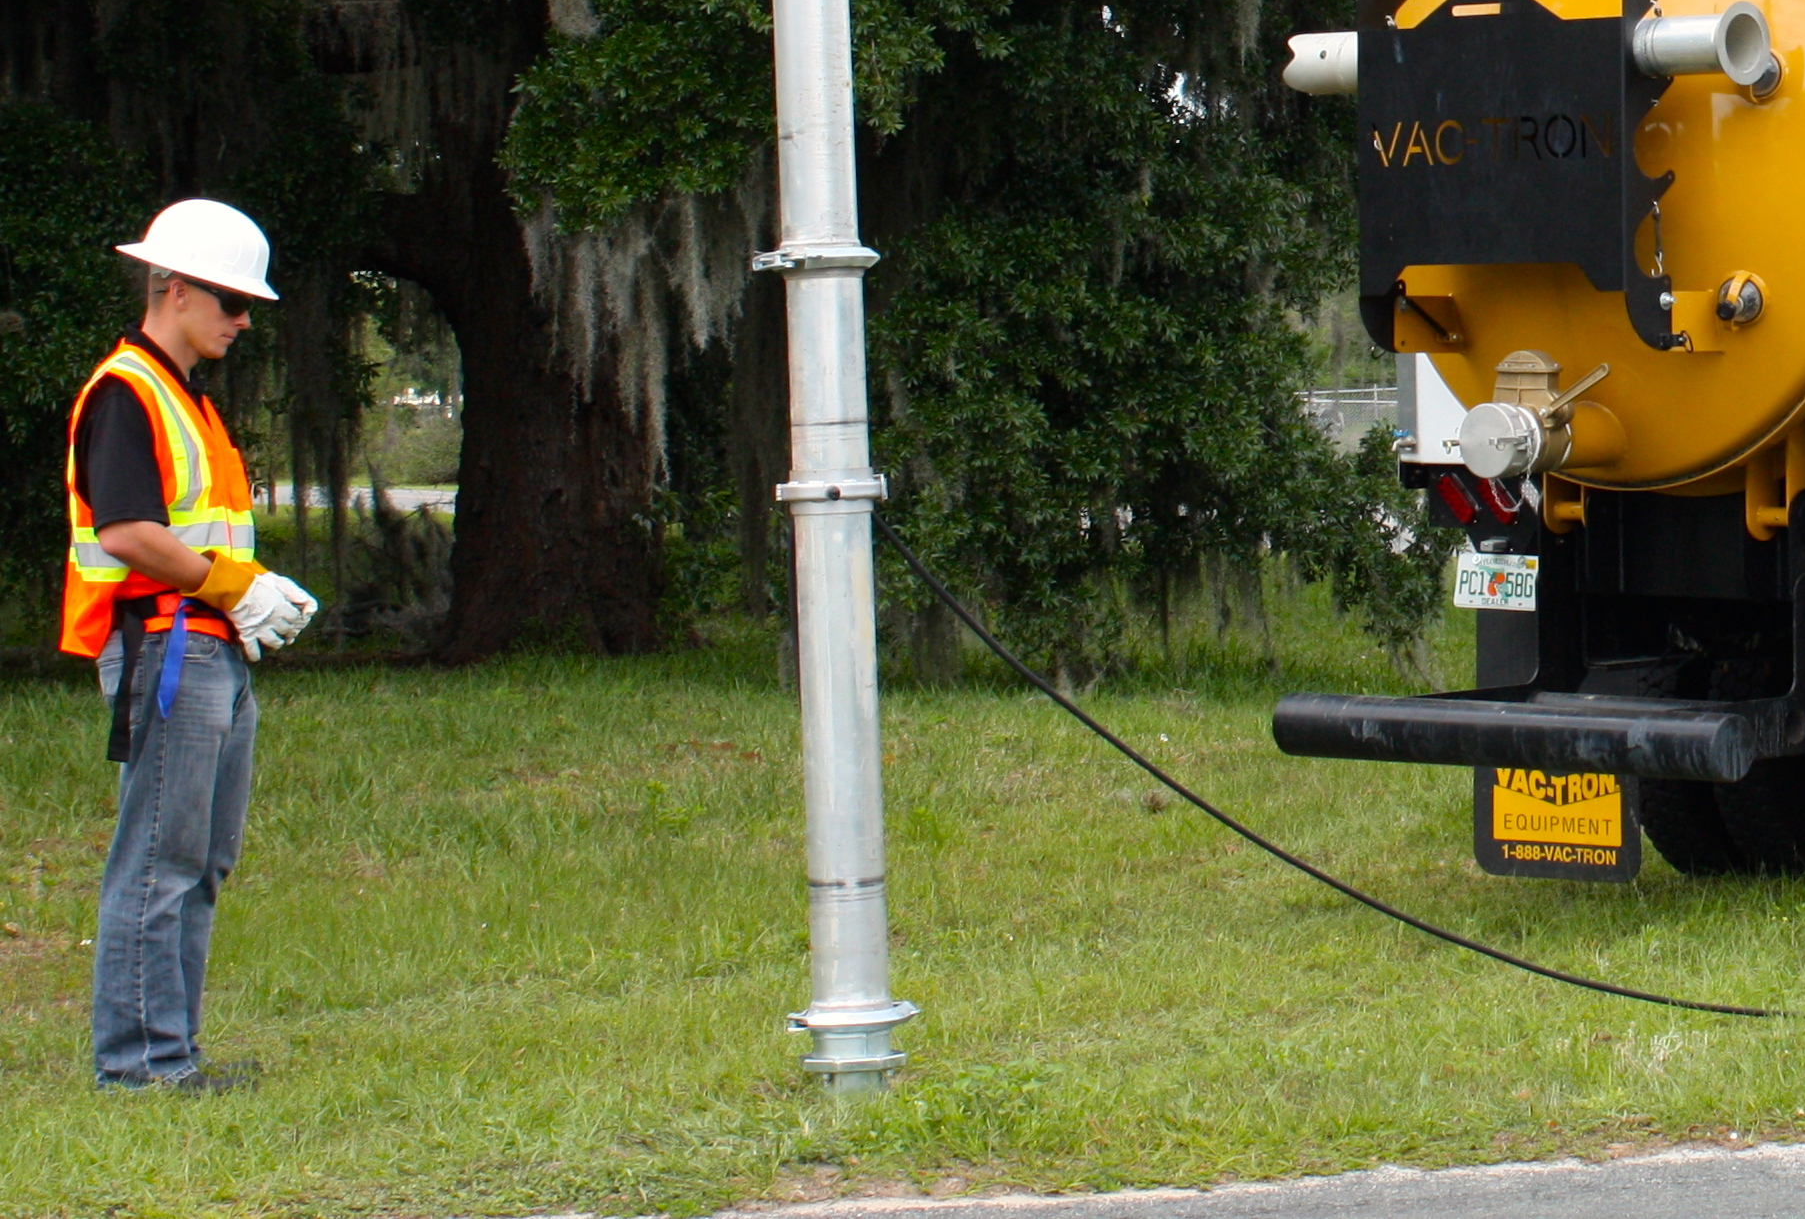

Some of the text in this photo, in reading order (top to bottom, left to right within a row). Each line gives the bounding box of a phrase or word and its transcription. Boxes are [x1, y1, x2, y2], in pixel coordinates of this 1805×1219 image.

[1371, 113, 1612, 168] VAC-TRON
[1496, 767, 1616, 806] VAC-TRON
[1503, 813, 1613, 836] EQUIPMENT
[1501, 843, 1617, 866] 1-888-VAC-TRON
